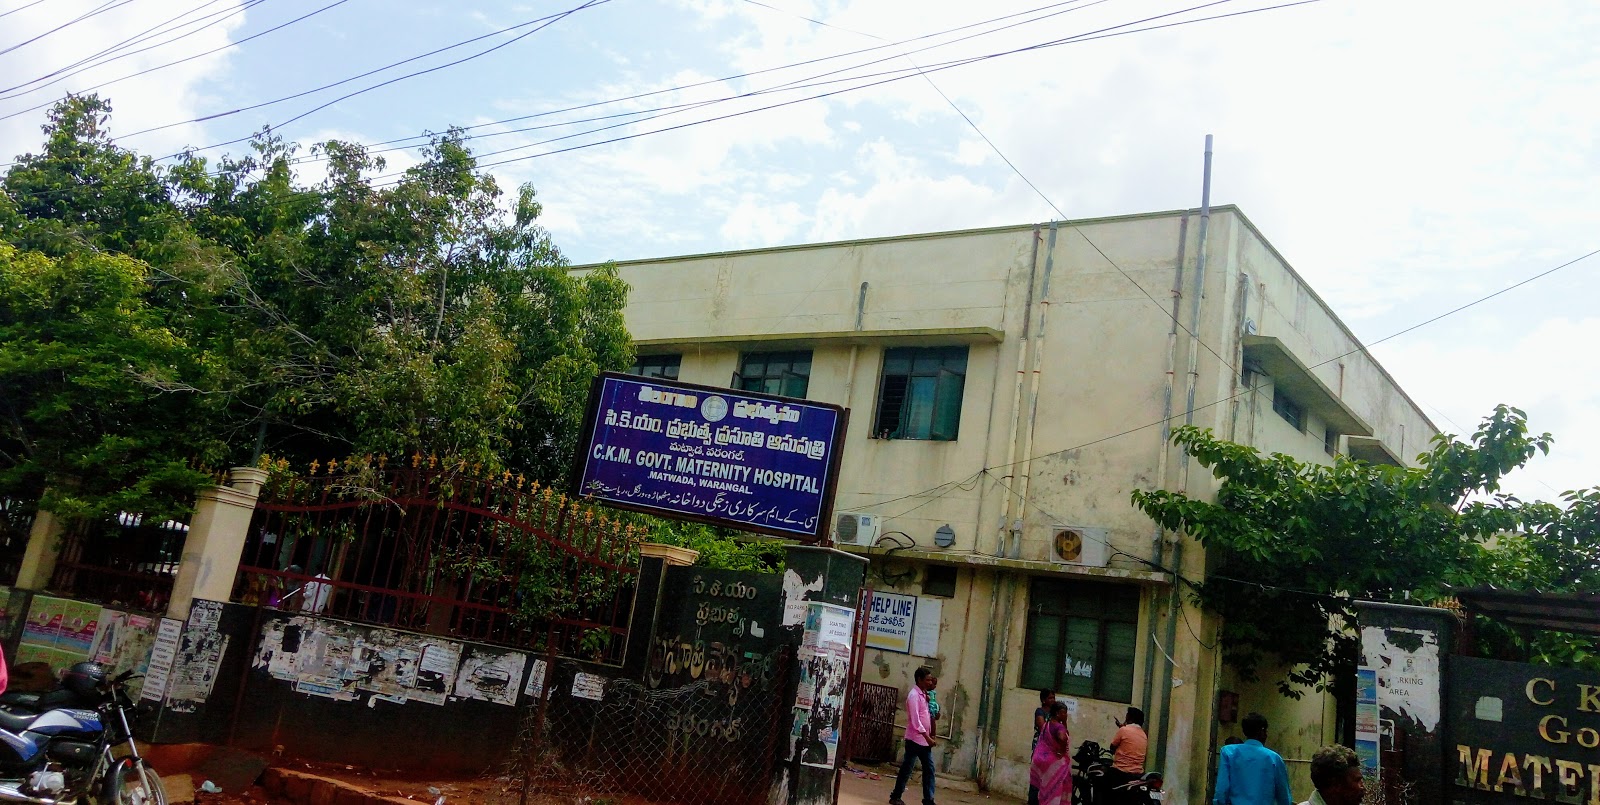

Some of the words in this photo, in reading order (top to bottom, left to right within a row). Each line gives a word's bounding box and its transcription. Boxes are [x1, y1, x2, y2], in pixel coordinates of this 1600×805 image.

[666, 417, 712, 446] ప్రభుత్వ
[714, 425, 765, 448] ప్రసూతి
[766, 434, 825, 460] ఆసుపత్రి
[593, 443, 632, 464] C.K.M.
[636, 450, 672, 470] GOVT.
[675, 456, 752, 483] MATERNITY
[753, 467, 819, 494] HOSPITAL
[649, 470, 696, 488] MATWADA,
[699, 479, 753, 495] WARANGAL.
[870, 596, 890, 614] HELP
[892, 599, 912, 617] LINE
[1389, 688, 1410, 697] AREA
[1525, 677, 1555, 706] C
